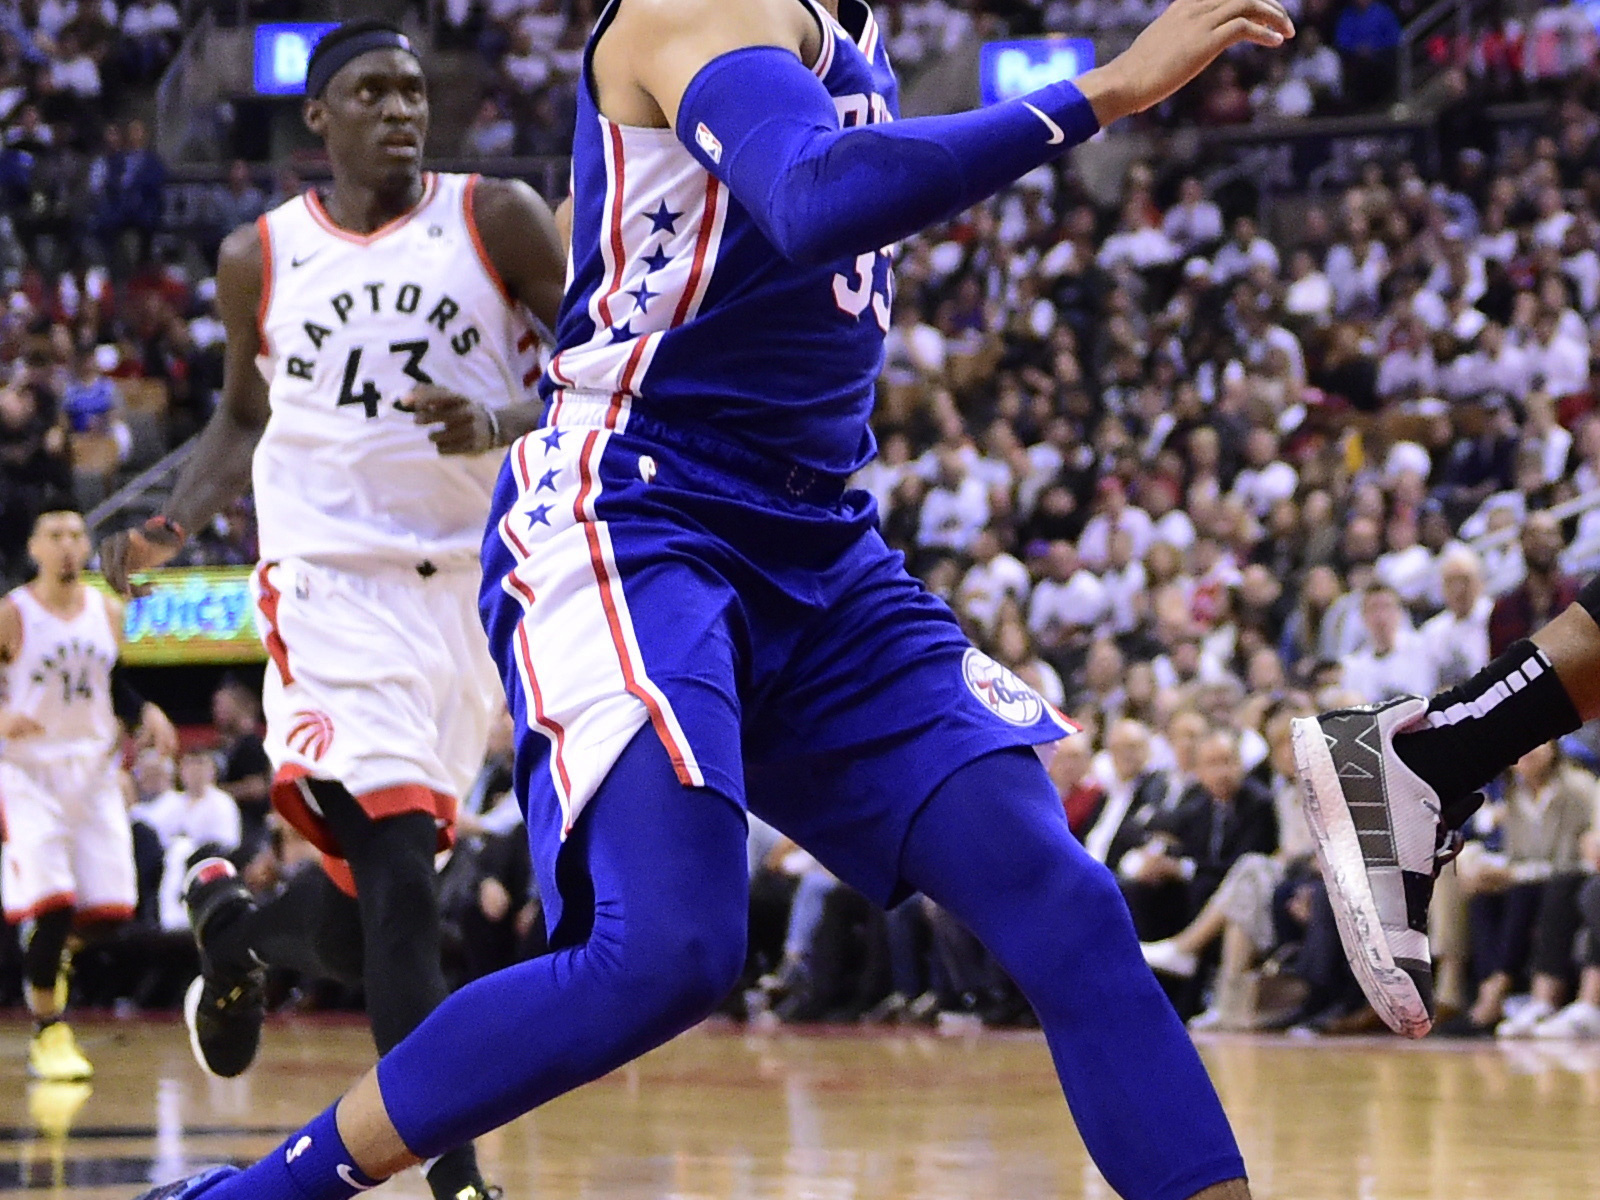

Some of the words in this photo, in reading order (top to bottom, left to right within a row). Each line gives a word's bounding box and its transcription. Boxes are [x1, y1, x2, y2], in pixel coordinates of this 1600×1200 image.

[286, 281, 481, 381] RAPTORS
[337, 338, 433, 418] 43
[61, 667, 92, 703] 14
